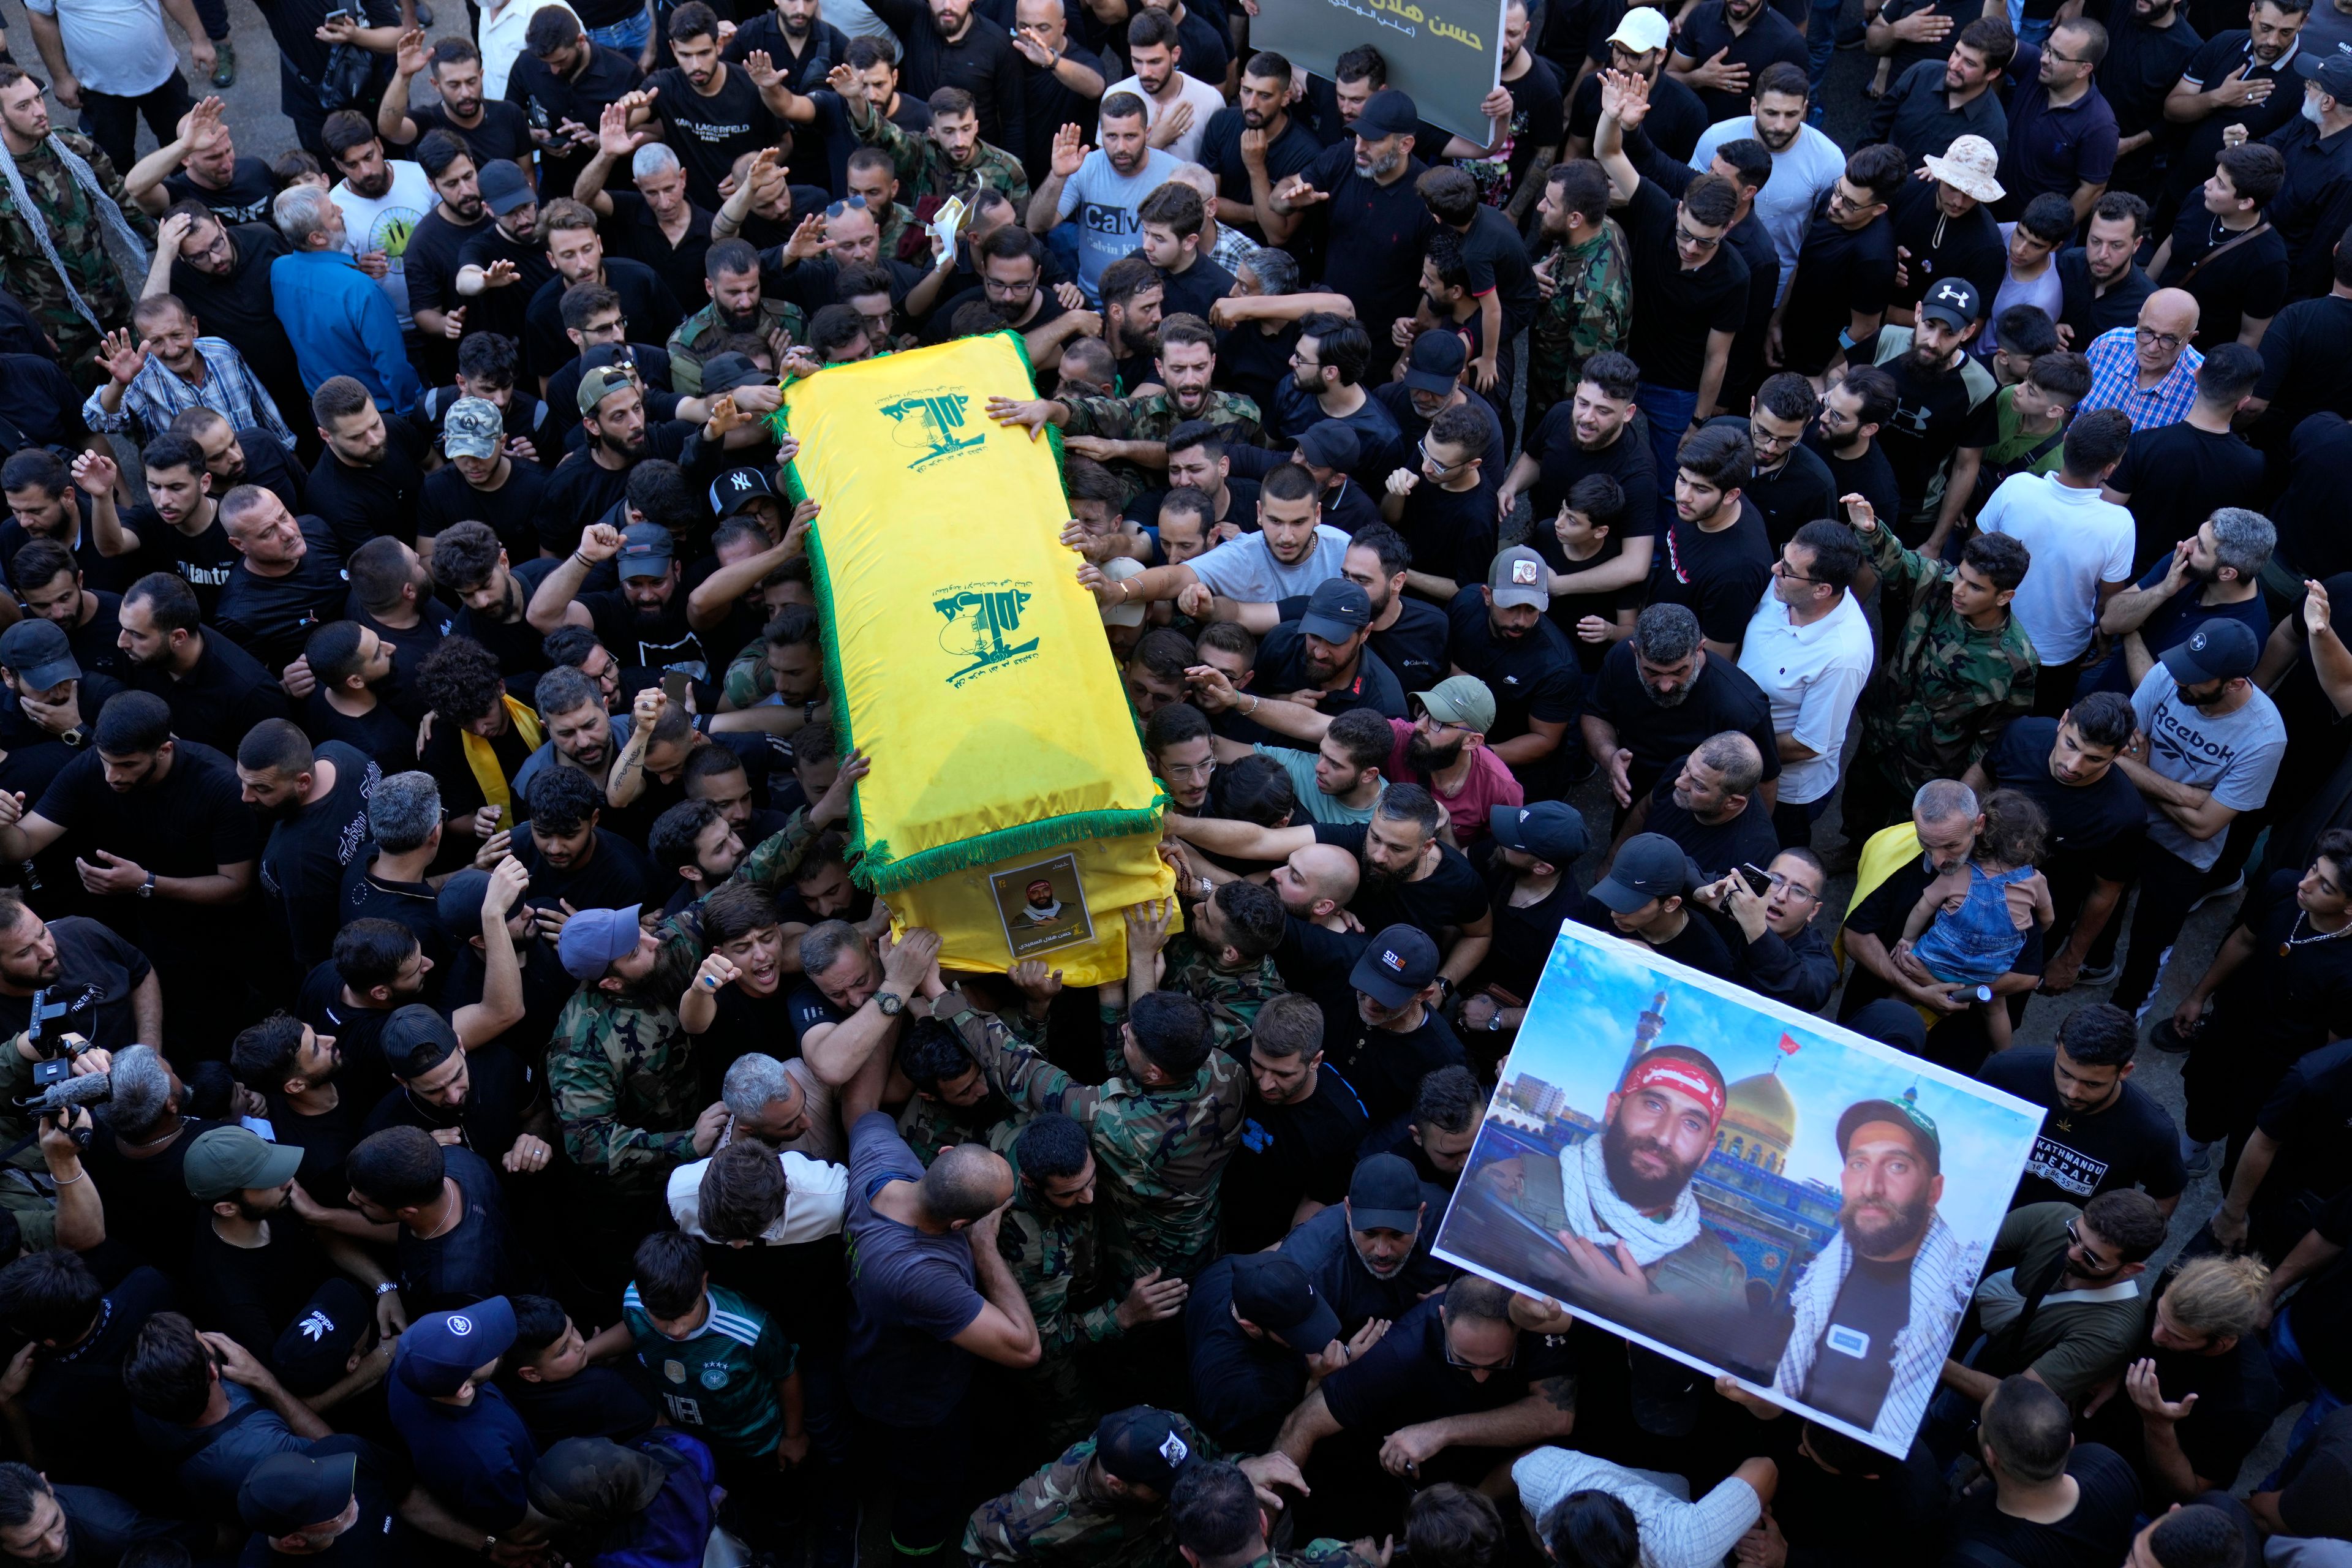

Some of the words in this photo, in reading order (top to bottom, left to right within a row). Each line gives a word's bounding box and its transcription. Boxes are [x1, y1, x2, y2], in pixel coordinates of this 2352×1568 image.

[1428, 15, 1482, 51] حسن
[695, 122, 750, 134] LAGERFELD
[2154, 703, 2235, 763] Reebok
[2034, 1151, 2092, 1184] NEPAL
[2037, 1140, 2103, 1175] KATHMANDU
[311, 1310, 334, 1332] adidas
[662, 1391, 704, 1426] 18
